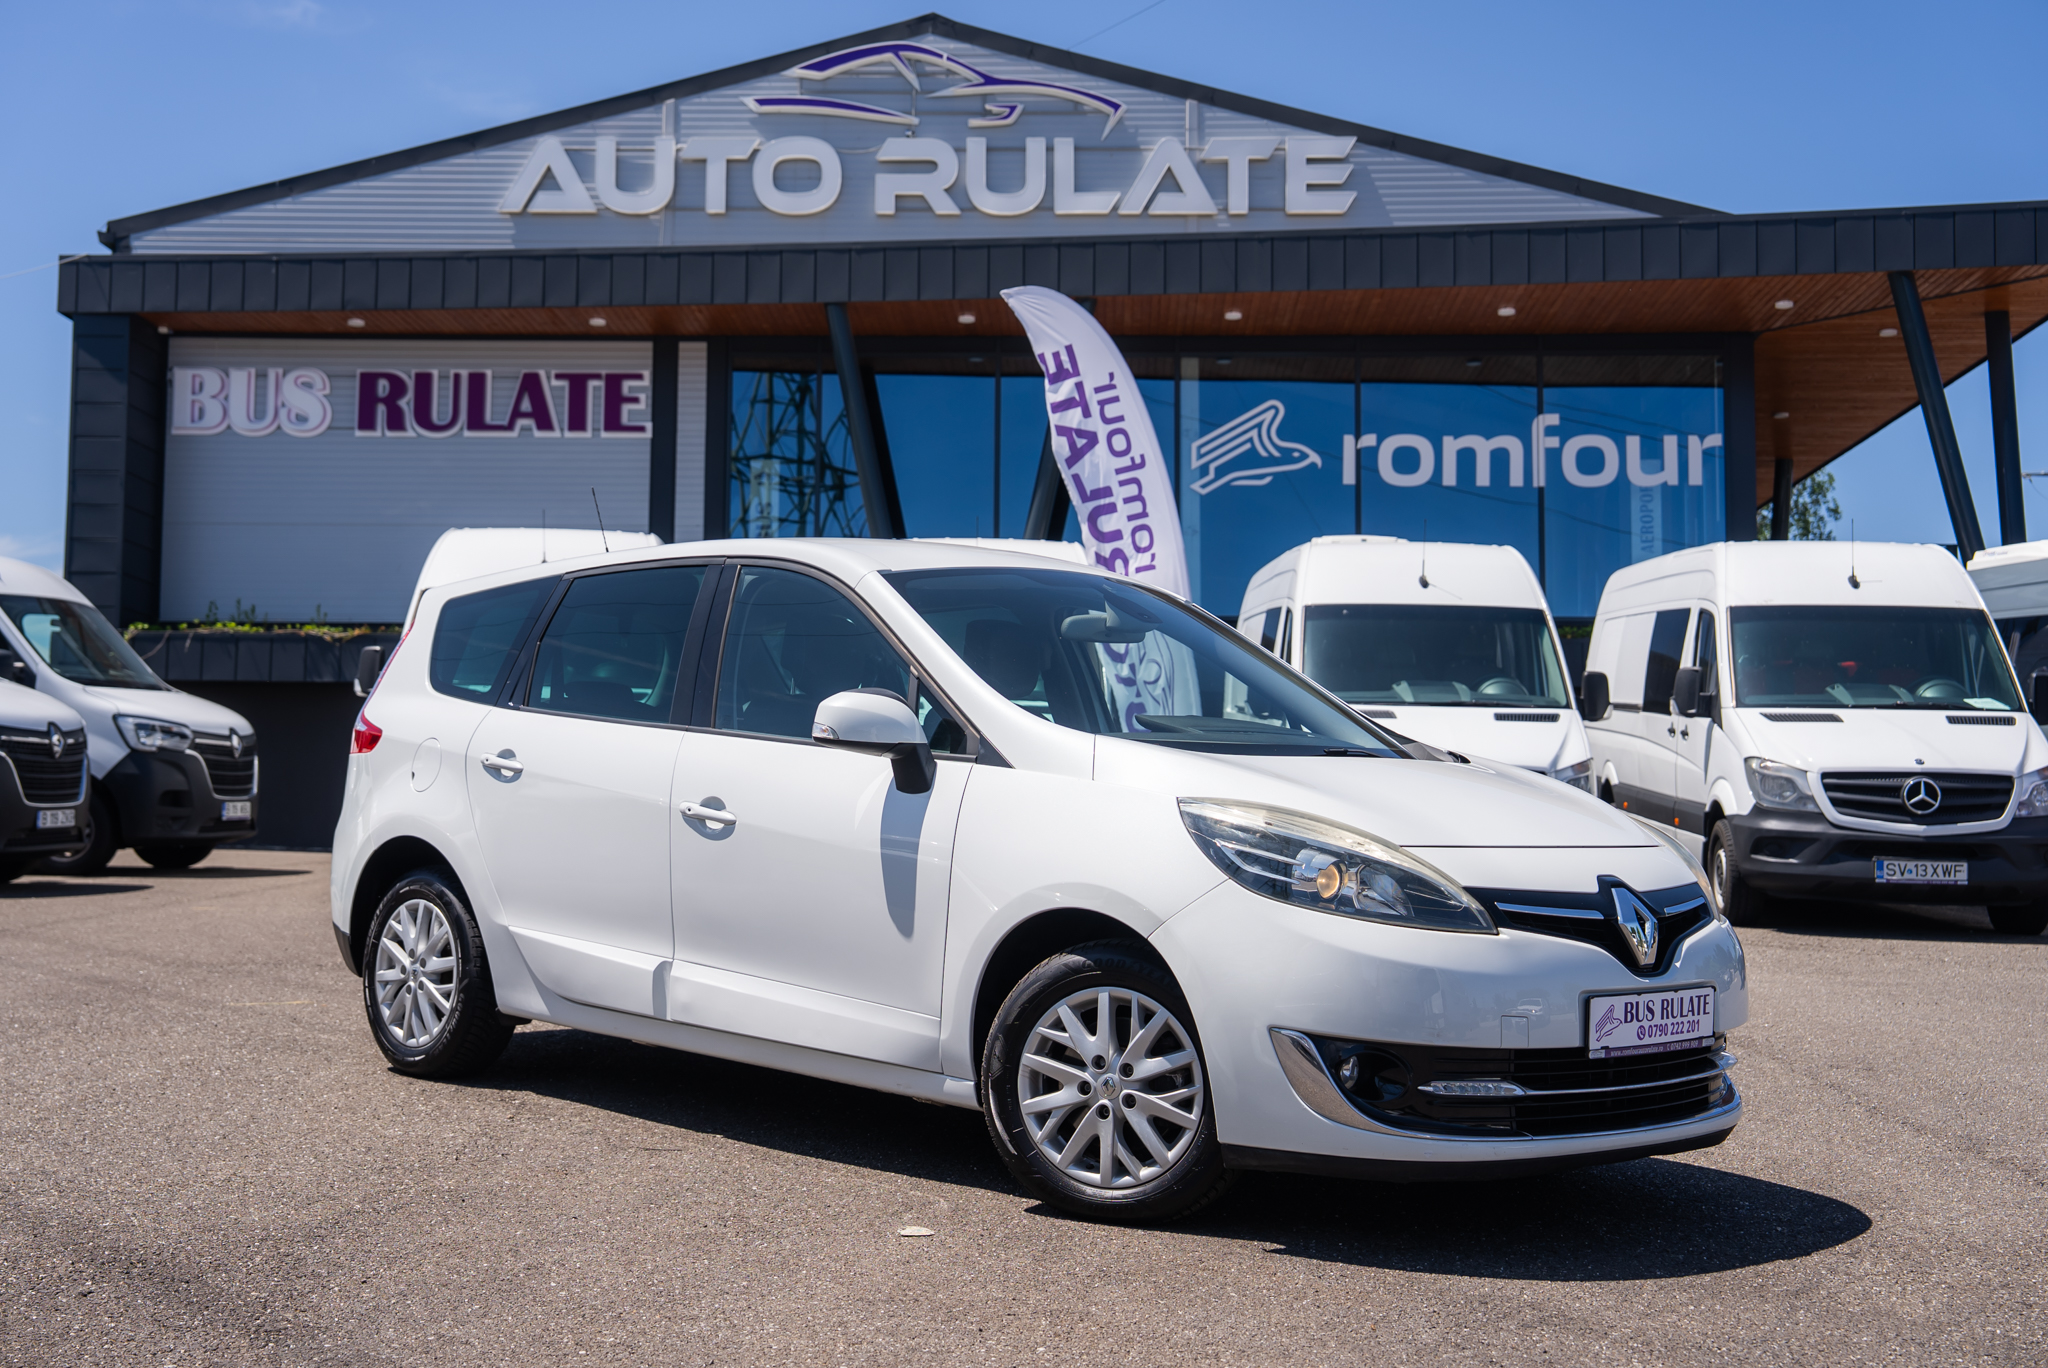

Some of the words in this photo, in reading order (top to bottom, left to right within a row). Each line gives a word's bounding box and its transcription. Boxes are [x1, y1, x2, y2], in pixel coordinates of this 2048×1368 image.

[497, 134, 844, 217] AUTO
[873, 135, 1358, 217] RULATE
[170, 366, 333, 437] BUS
[355, 368, 653, 438] RULATE
[1342, 413, 1723, 488] romfour
[1623, 1000, 1655, 1024] BUS
[1661, 994, 1710, 1020] RULATE
[1647, 1023, 1669, 1038] 0790
[1670, 1021, 1685, 1036] 222
[1686, 1018, 1700, 1034] 201
